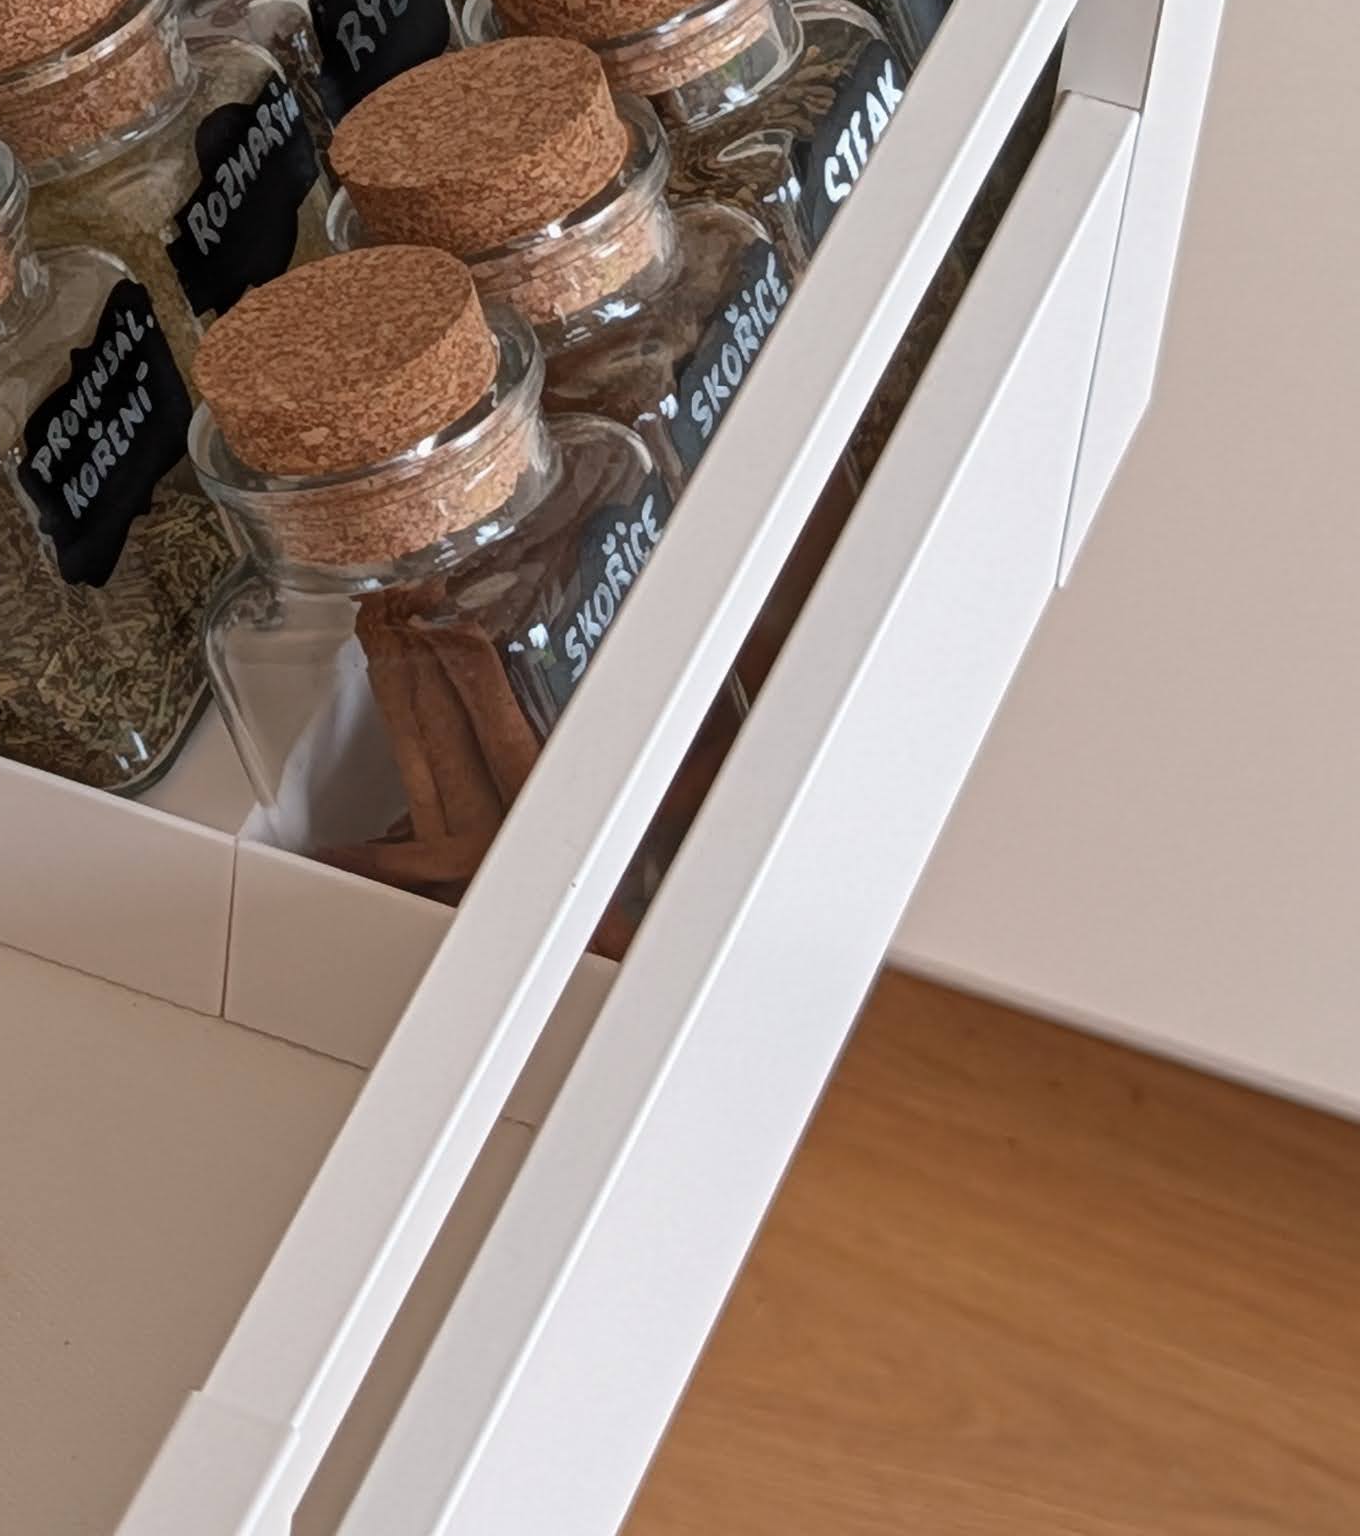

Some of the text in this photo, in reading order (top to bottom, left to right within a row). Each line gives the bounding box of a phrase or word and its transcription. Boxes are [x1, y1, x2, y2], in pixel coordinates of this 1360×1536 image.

[188, 81, 299, 255] ROZMARÝN
[691, 251, 788, 438] SKOŘICE
[63, 361, 152, 519] KOŘENÍ
[565, 494, 663, 682] SKOŘICE
